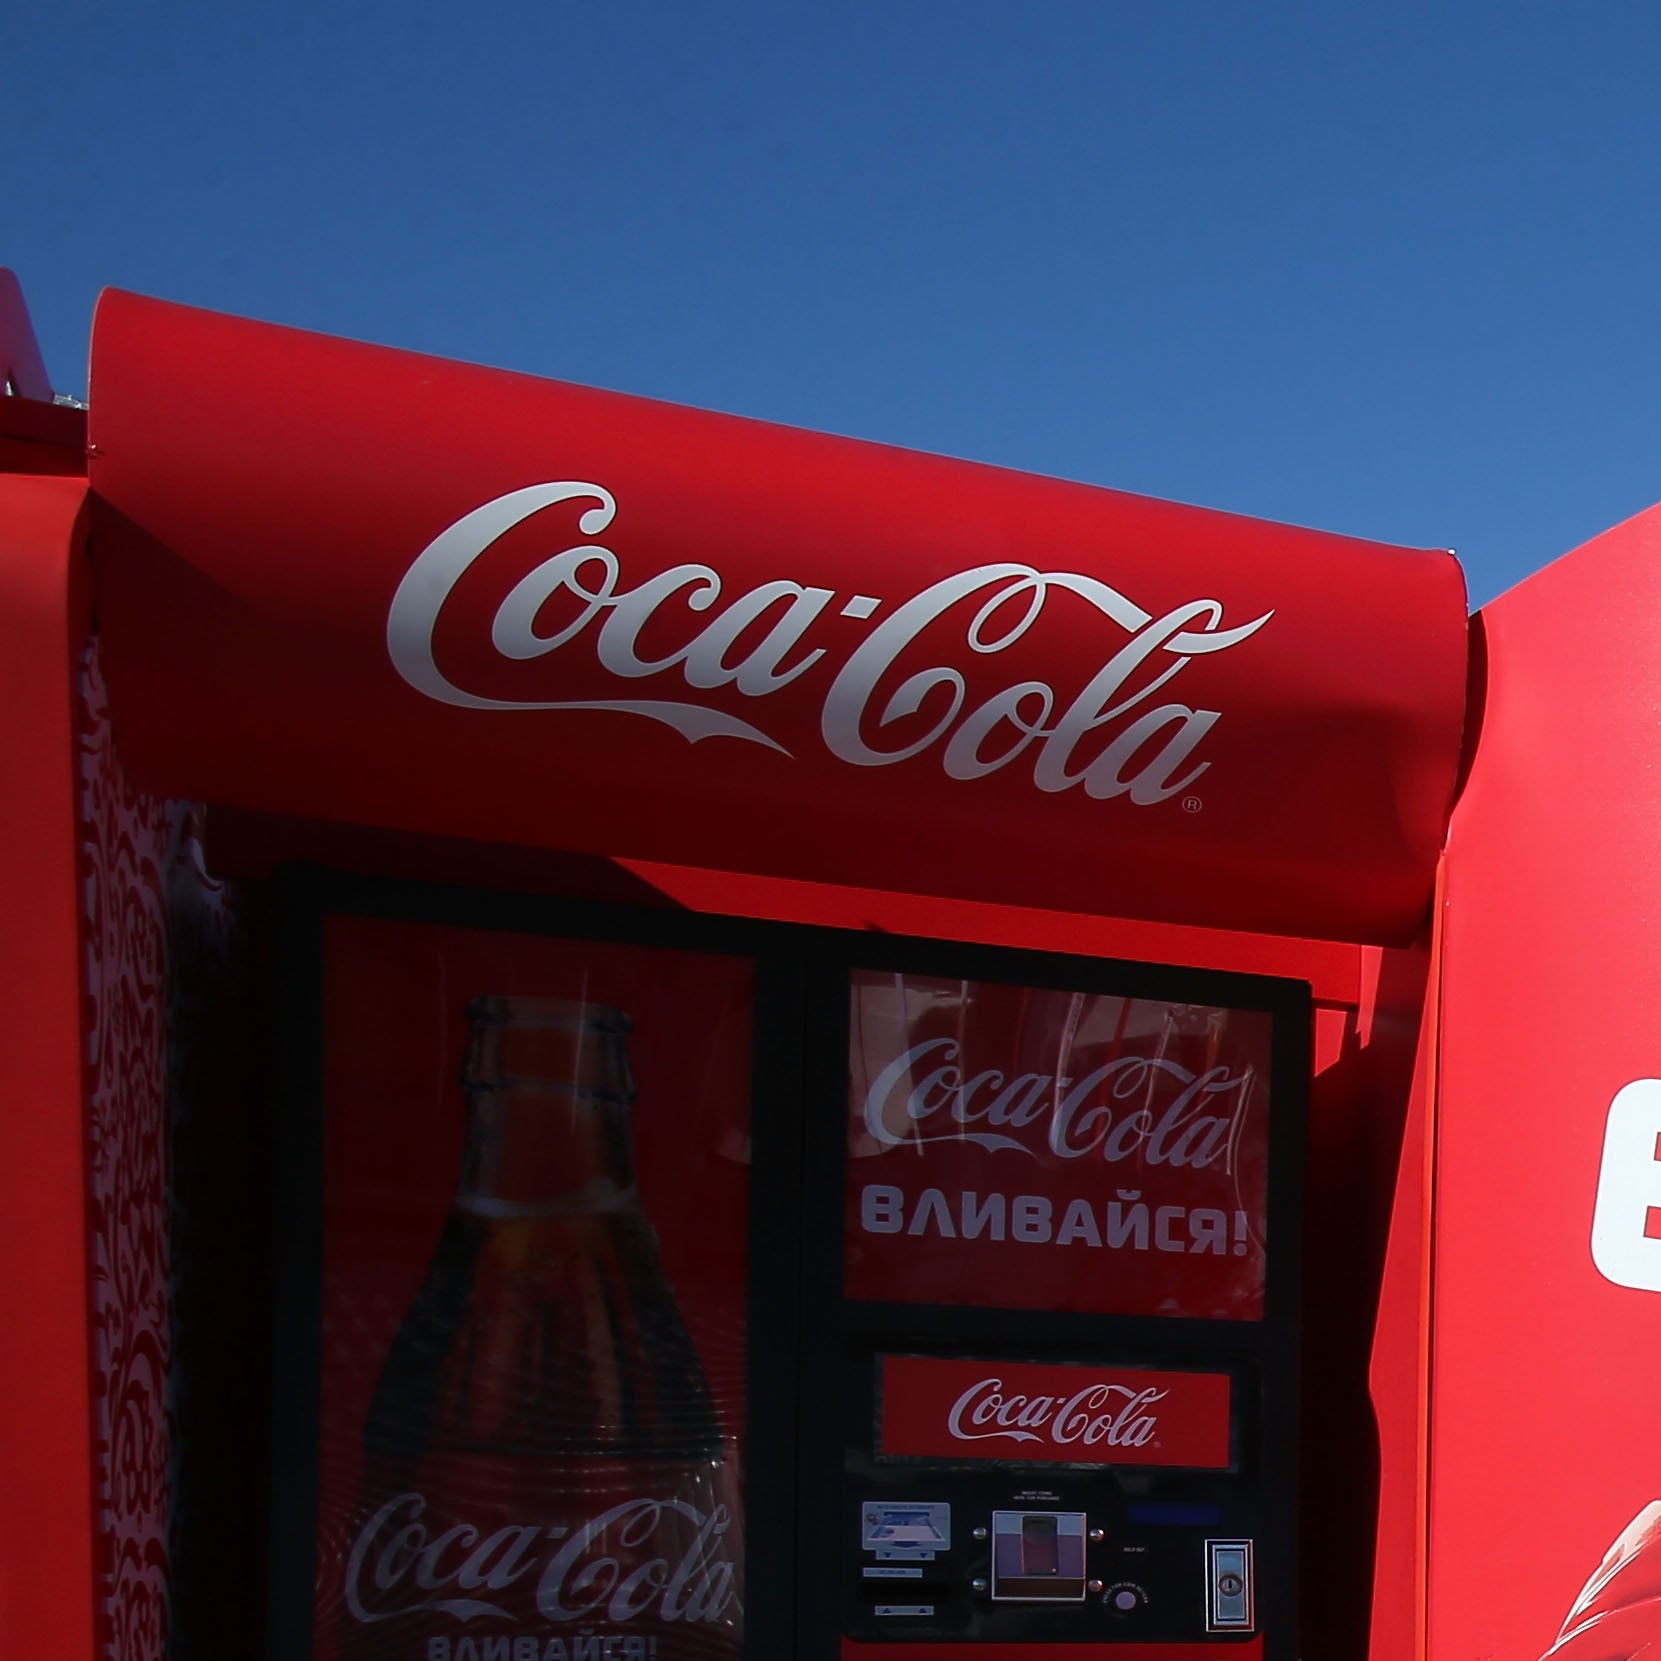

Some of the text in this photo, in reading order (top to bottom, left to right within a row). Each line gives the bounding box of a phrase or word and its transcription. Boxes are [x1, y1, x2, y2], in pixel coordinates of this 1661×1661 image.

[387, 481, 1275, 806] Coca-Cola
[864, 1037, 1254, 1168] Coca-Cola
[861, 1184, 1249, 1257] ВЛИВАЙСЯ!
[948, 1378, 1170, 1447] Coca-Cola
[345, 1493, 736, 1624] Coca-Cola
